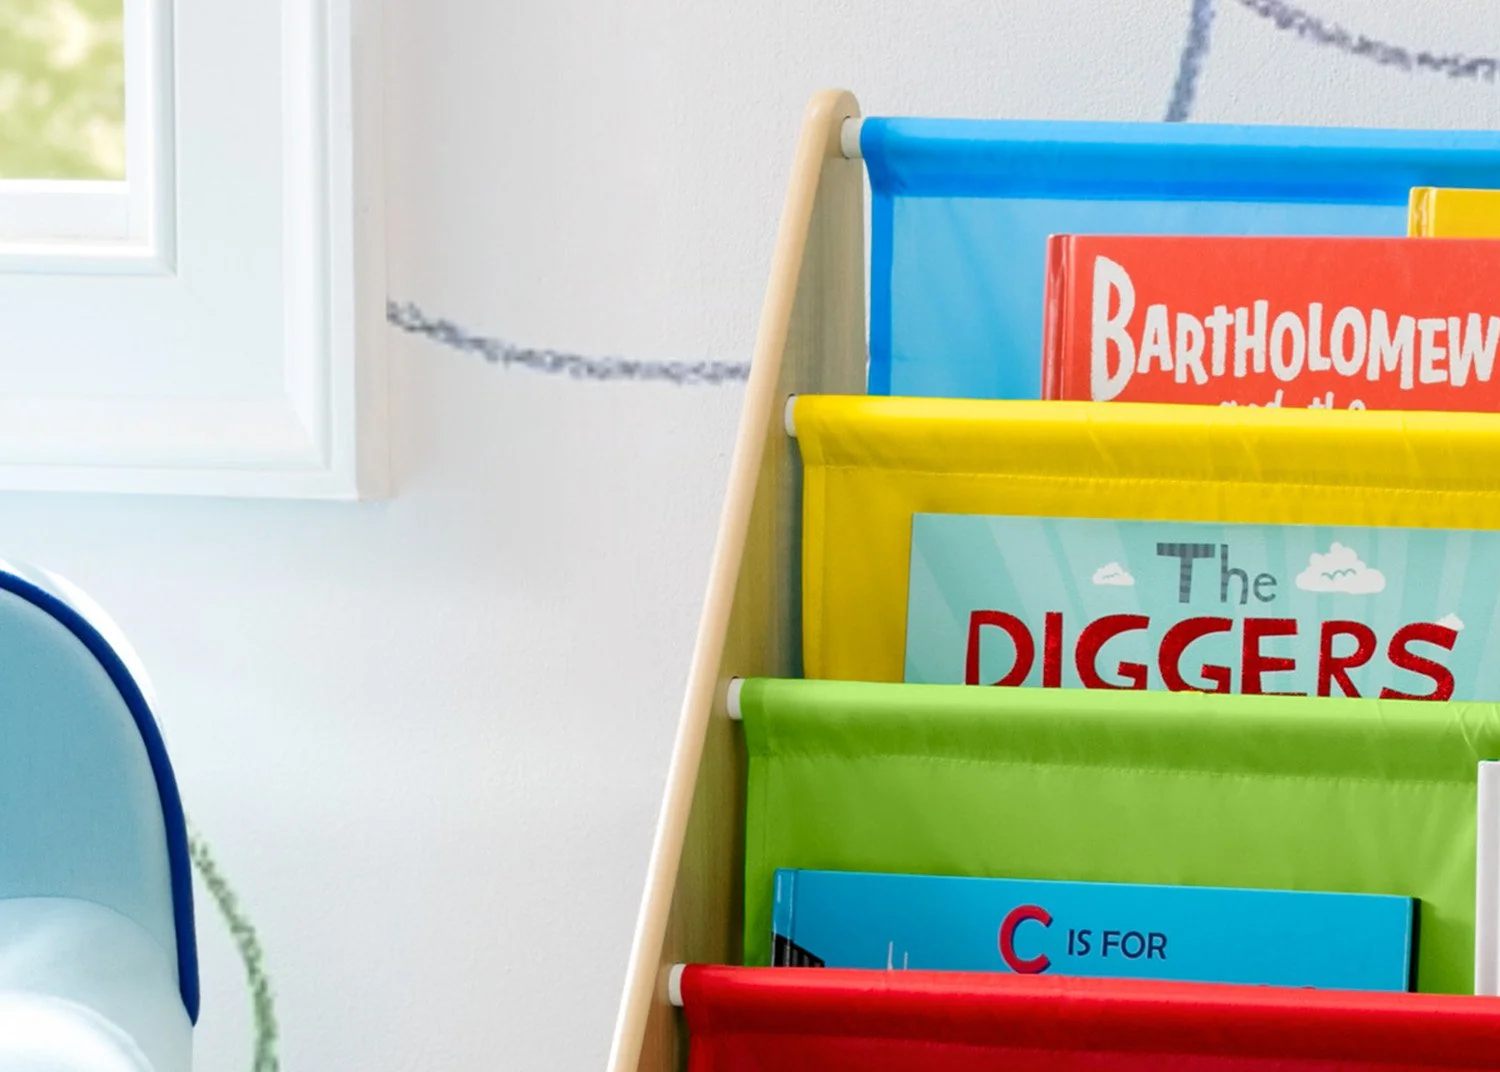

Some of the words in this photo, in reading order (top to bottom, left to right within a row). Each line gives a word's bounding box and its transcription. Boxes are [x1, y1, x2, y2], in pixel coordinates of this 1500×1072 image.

[1156, 542, 1278, 604] The
[965, 610, 1459, 702] DIGGERS
[999, 904, 1053, 975] C
[1067, 928, 1091, 957] IS
[1101, 930, 1168, 960] FOR
